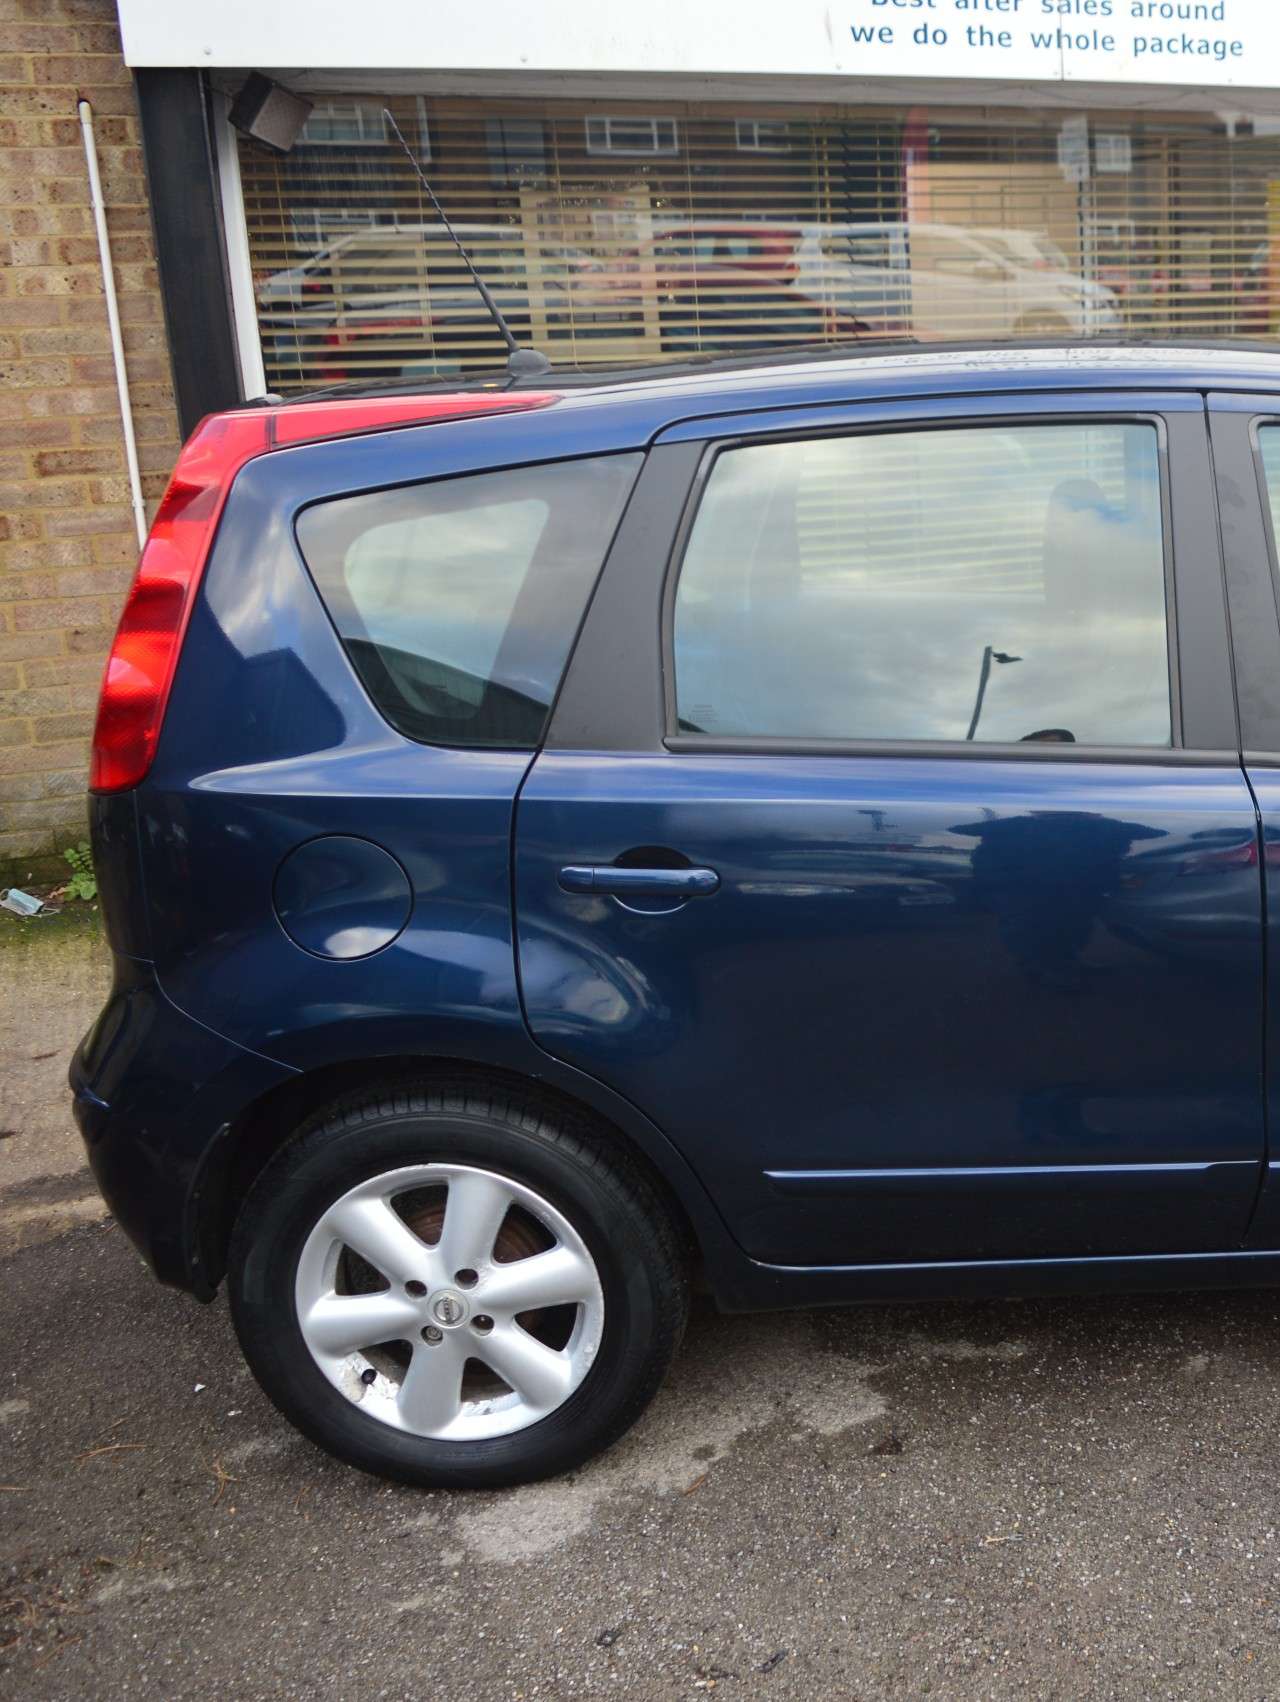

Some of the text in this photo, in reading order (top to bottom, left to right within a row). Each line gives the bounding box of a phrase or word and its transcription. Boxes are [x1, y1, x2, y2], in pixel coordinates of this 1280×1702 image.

[1041, 0, 1113, 16] sales
[1131, 0, 1225, 21] around
[850, 22, 1244, 61] we do the whole package
